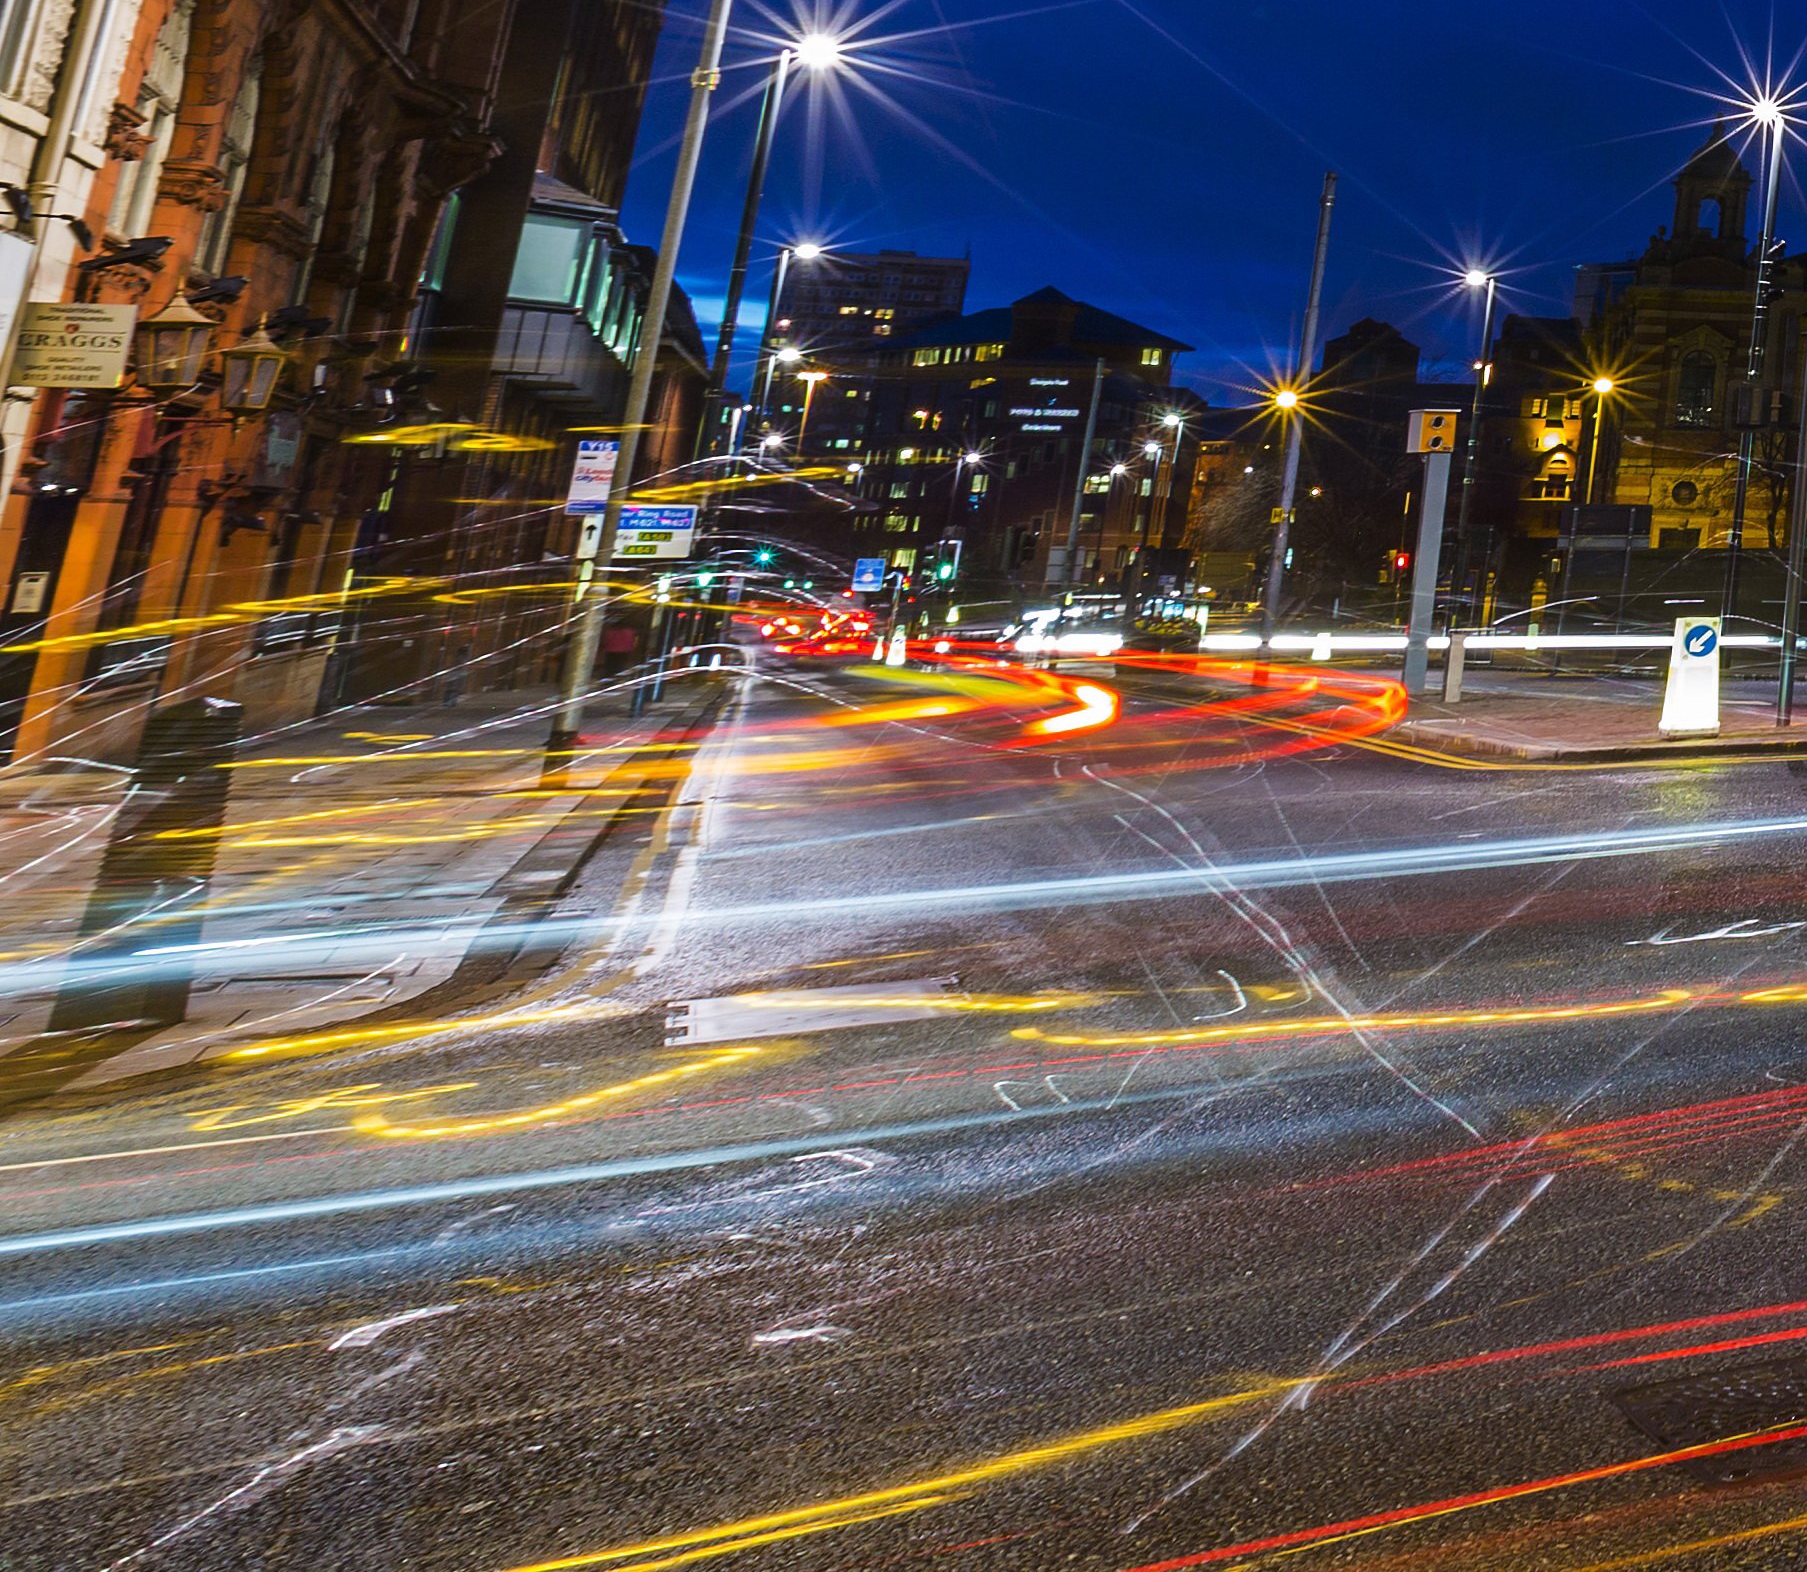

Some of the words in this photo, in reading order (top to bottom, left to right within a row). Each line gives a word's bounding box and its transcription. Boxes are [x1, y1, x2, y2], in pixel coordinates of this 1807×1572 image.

[18, 334, 122, 348] CRAGGS
[588, 441, 613, 451] Y15
[637, 510, 660, 519] Ring
[663, 509, 689, 517] Road
